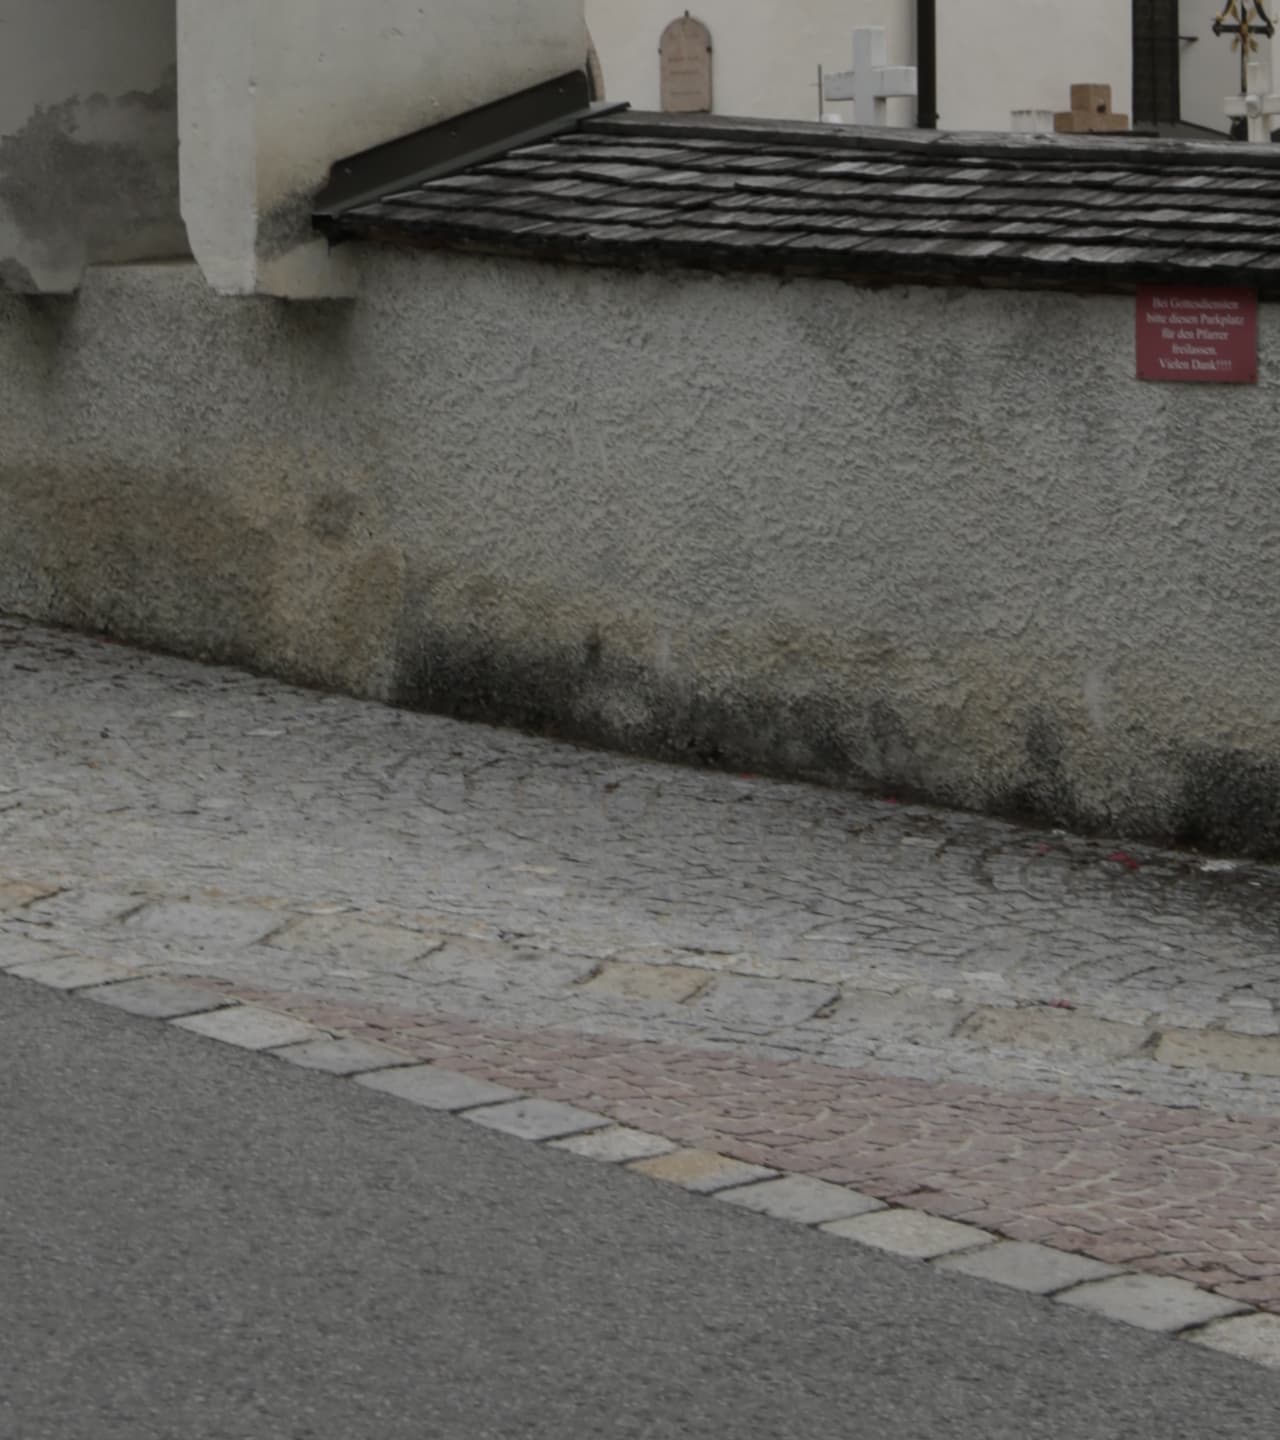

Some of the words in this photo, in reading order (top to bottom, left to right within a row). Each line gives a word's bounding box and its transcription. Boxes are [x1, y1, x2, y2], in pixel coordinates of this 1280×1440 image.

[1152, 296, 1168, 309] Bei
[1170, 296, 1239, 310] Gottesdiensten
[1146, 312, 1167, 324] bitte
[1168, 313, 1198, 325] diesen
[1200, 313, 1245, 328] Parkplatz
[1162, 327, 1175, 339] für
[1177, 327, 1195, 339] den
[1196, 327, 1228, 340] Pfarrer
[1159, 357, 1190, 370] Vielen
